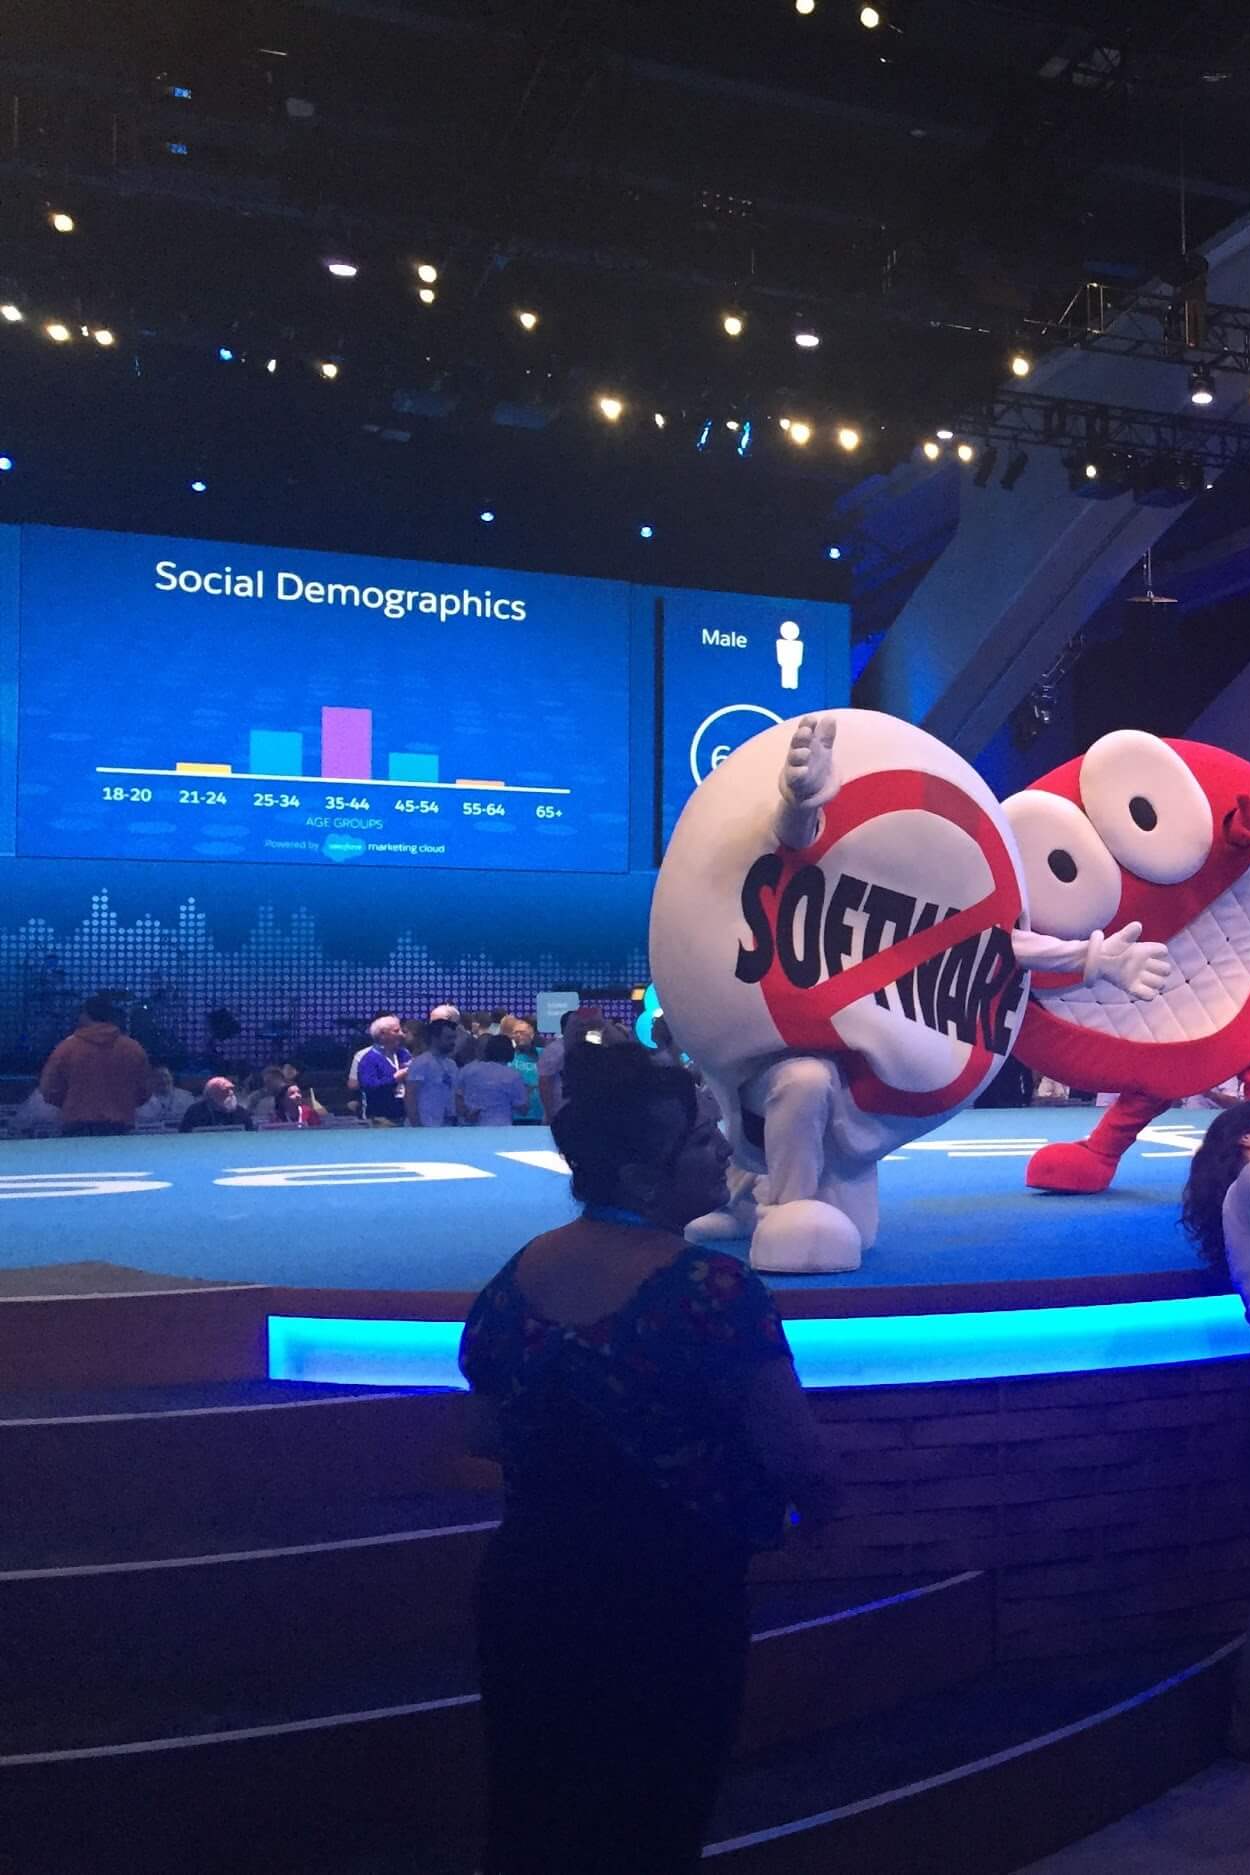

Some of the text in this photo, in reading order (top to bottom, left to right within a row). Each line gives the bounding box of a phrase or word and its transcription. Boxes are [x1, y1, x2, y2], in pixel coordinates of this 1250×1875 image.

[154, 560, 527, 623] Social Demographics
[701, 627, 748, 649] Male
[102, 786, 563, 818] 18-20 21-24 25-34 35-44 45-54 55-64 65+
[305, 816, 384, 830] AGE GROUPS
[264, 839, 306, 849] Powered
[307, 839, 320, 851] by
[367, 841, 418, 855] marketing
[418, 844, 446, 854] cloud
[735, 853, 1031, 1056] SOFTWARE
